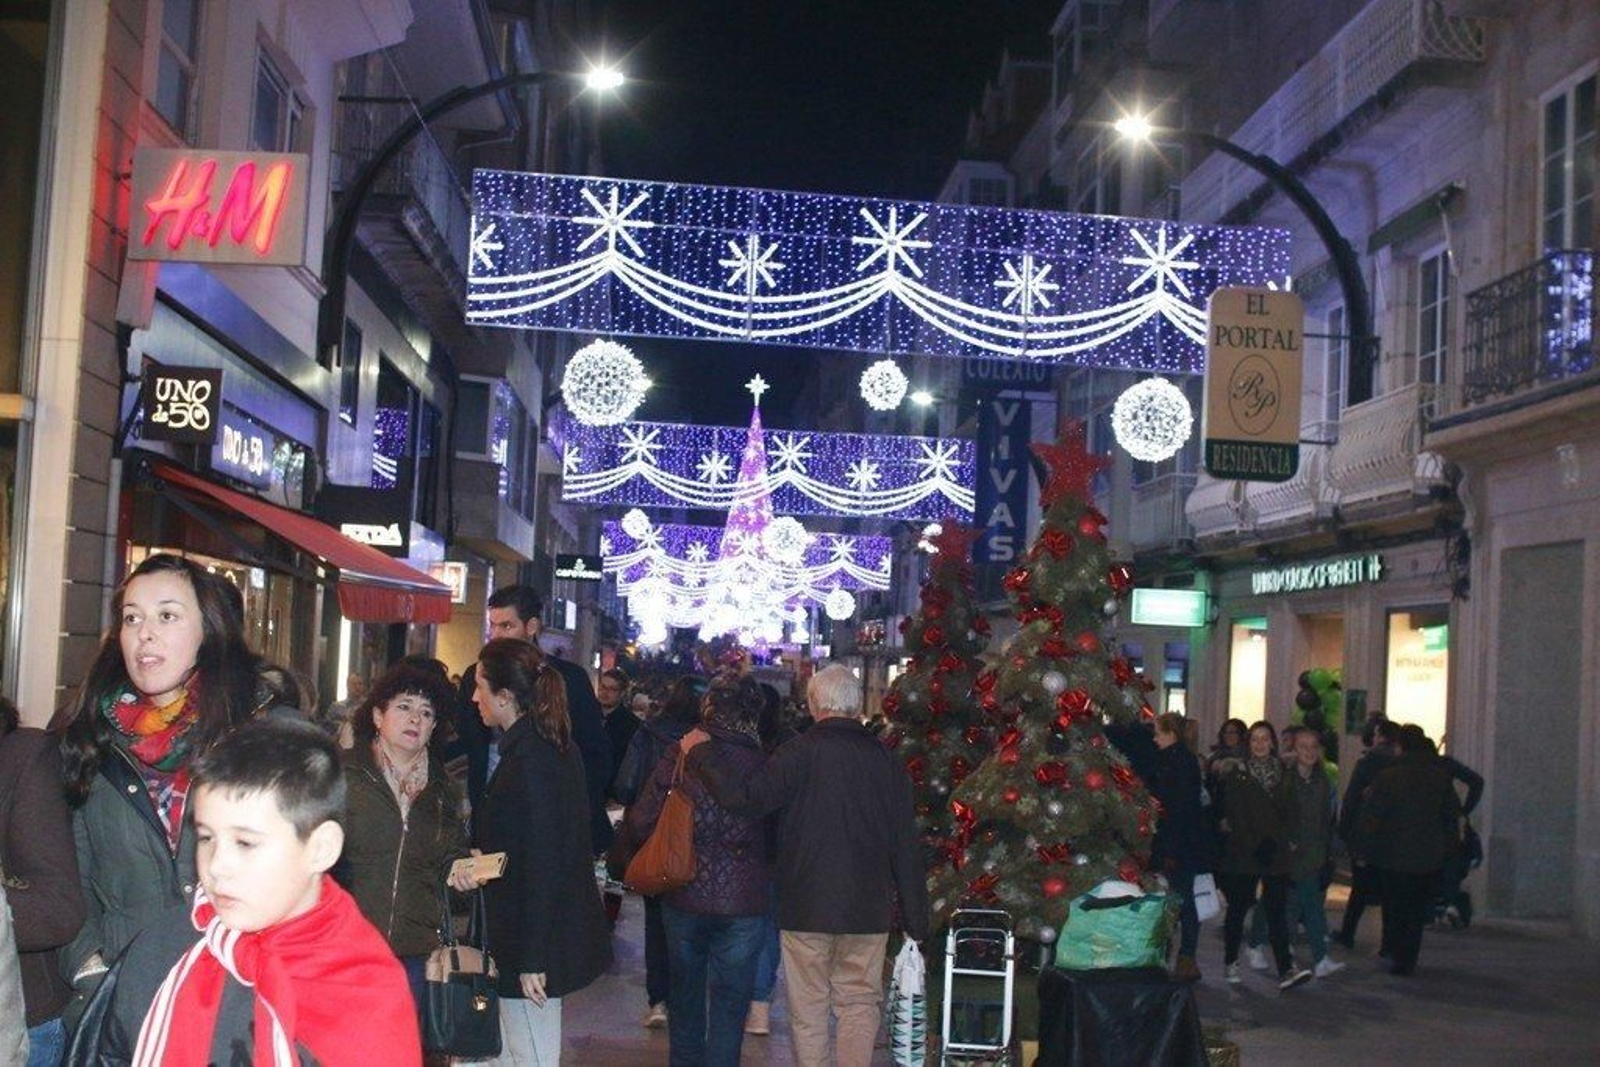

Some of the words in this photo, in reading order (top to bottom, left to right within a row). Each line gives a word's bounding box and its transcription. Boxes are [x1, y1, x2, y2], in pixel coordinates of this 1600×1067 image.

[143, 158, 292, 256] H&M
[1245, 294, 1269, 315] EL
[1214, 324, 1299, 351] PORTAL
[156, 378, 212, 403] UNO
[168, 402, 210, 430] 50
[1213, 444, 1292, 475] RESIDENCIA
[987, 402, 1020, 562] VIVAS
